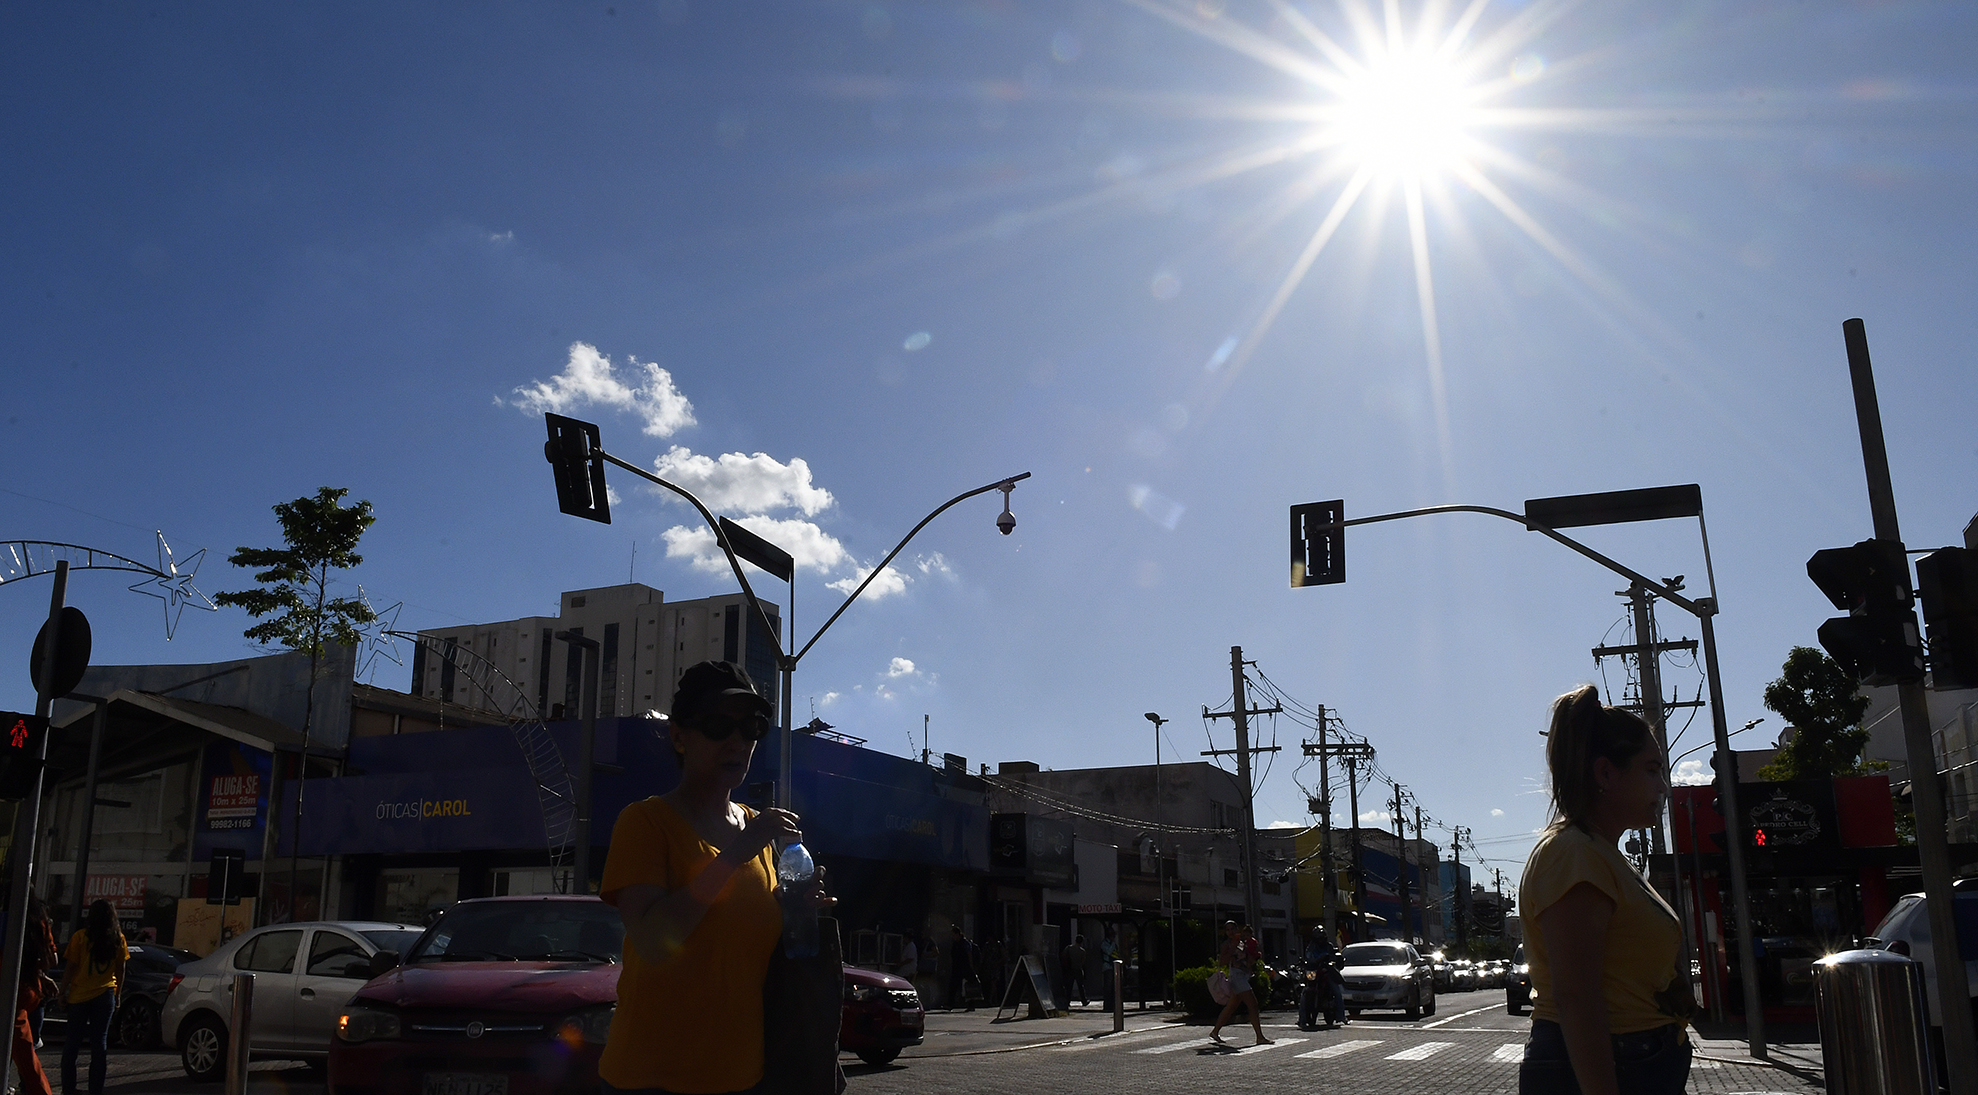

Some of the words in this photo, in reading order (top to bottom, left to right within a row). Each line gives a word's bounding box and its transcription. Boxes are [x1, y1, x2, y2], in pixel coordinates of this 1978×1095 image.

[212, 775, 259, 796] ALUGA-SE
[212, 797, 229, 806] 10m
[238, 796, 256, 805] 25m
[376, 800, 419, 820] ÓTICAS
[422, 799, 472, 818] CAROL
[1788, 820, 1808, 828] CELL
[87, 876, 146, 897] ALUGA-SE
[120, 897, 143, 906] 25m
